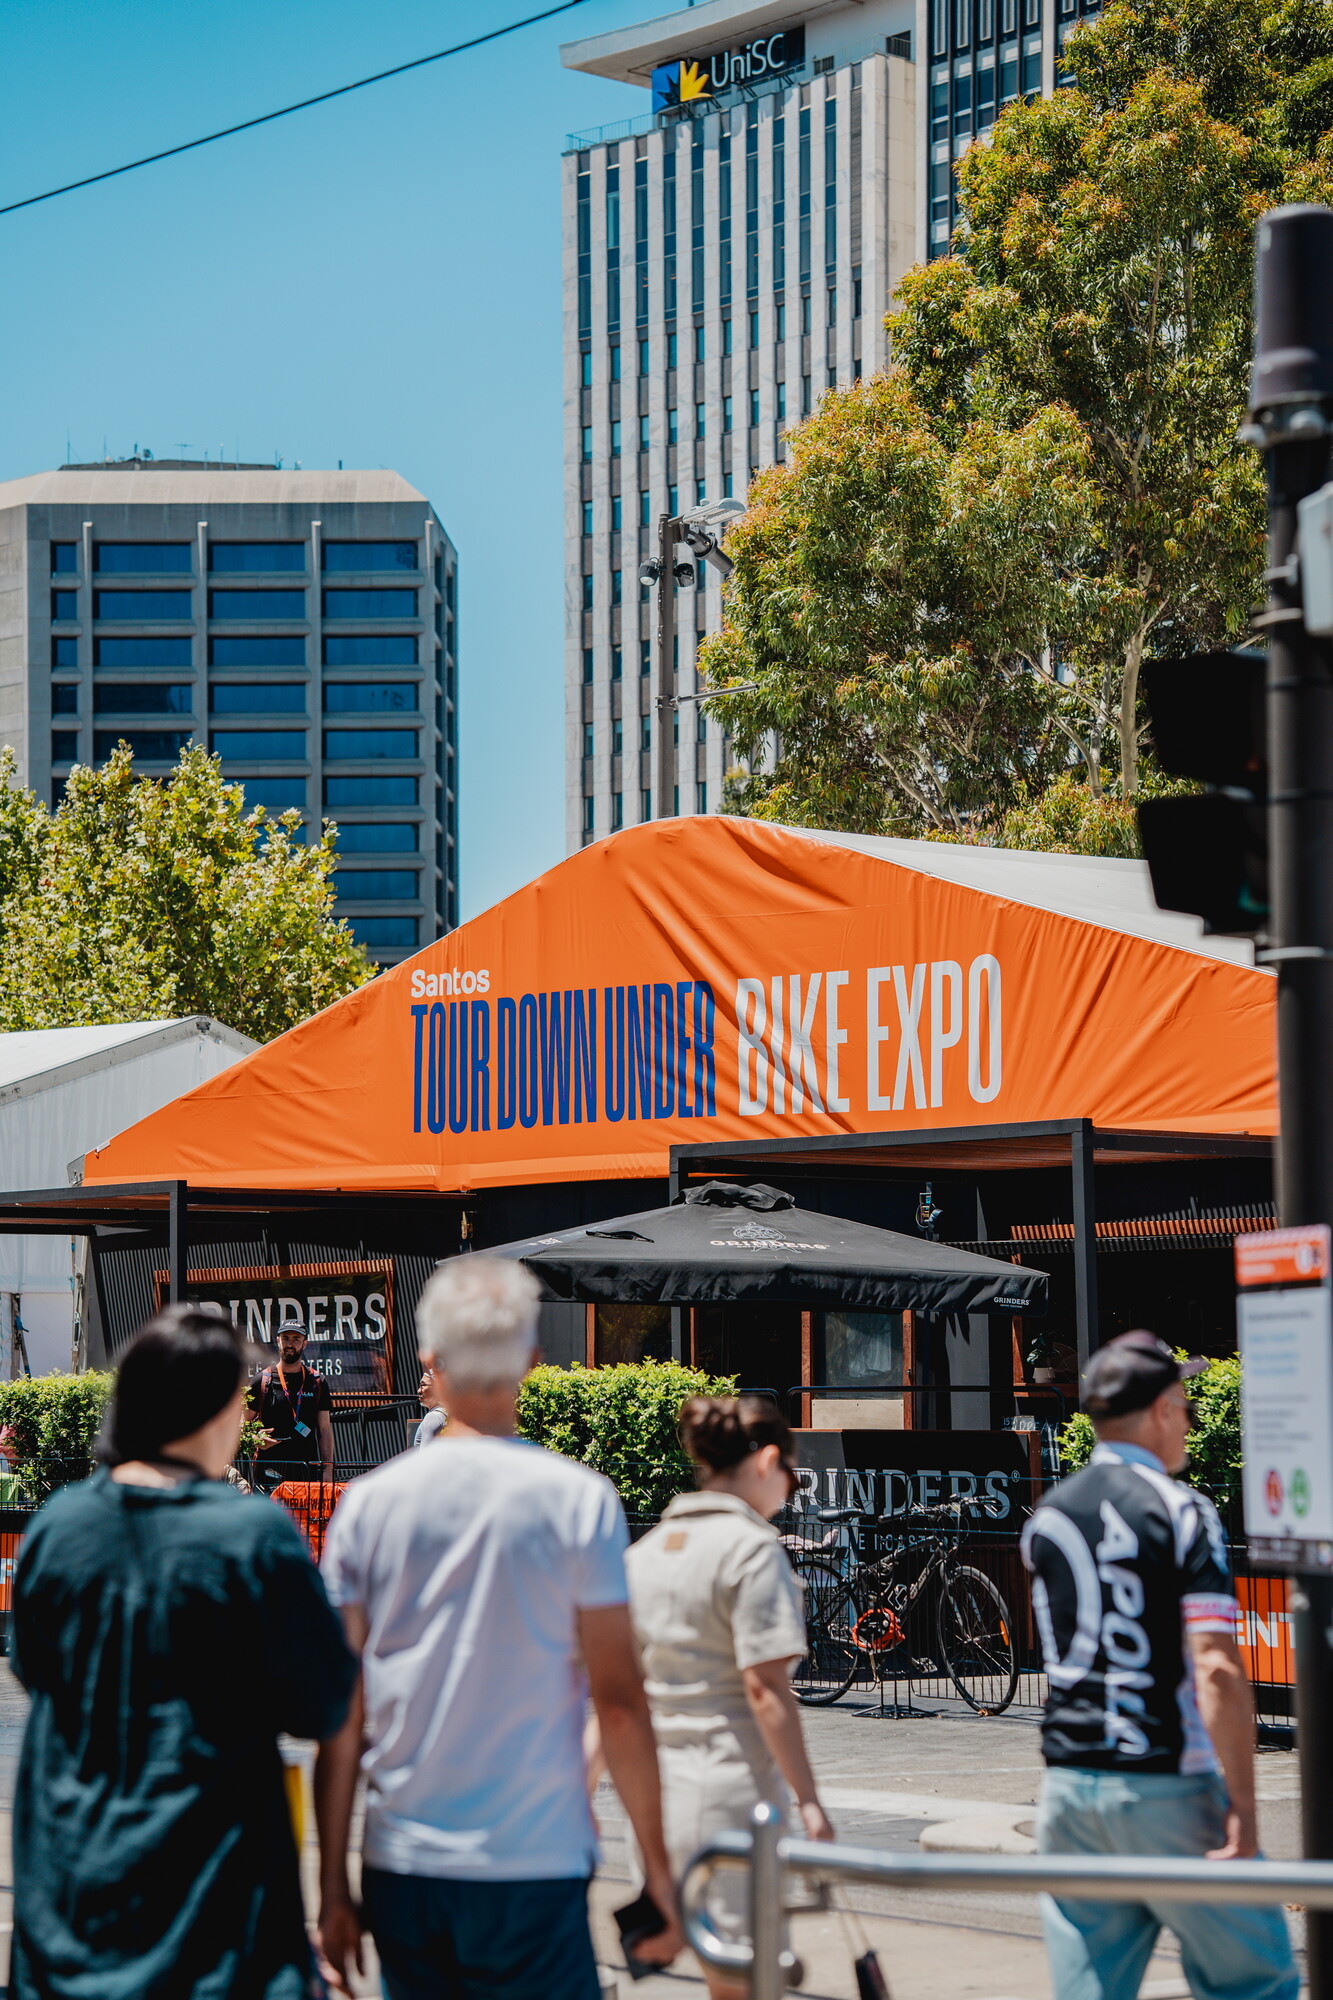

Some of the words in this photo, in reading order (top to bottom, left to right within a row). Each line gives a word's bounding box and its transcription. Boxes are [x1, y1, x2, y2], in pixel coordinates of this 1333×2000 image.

[711, 33, 785, 88] UniSC
[411, 967, 490, 998] Santos
[411, 1000, 491, 1135] TOUR
[497, 988, 598, 1131] DOWN
[604, 980, 717, 1123] UNDER
[735, 970, 850, 1116] BIKE
[867, 953, 1002, 1113] EXPO
